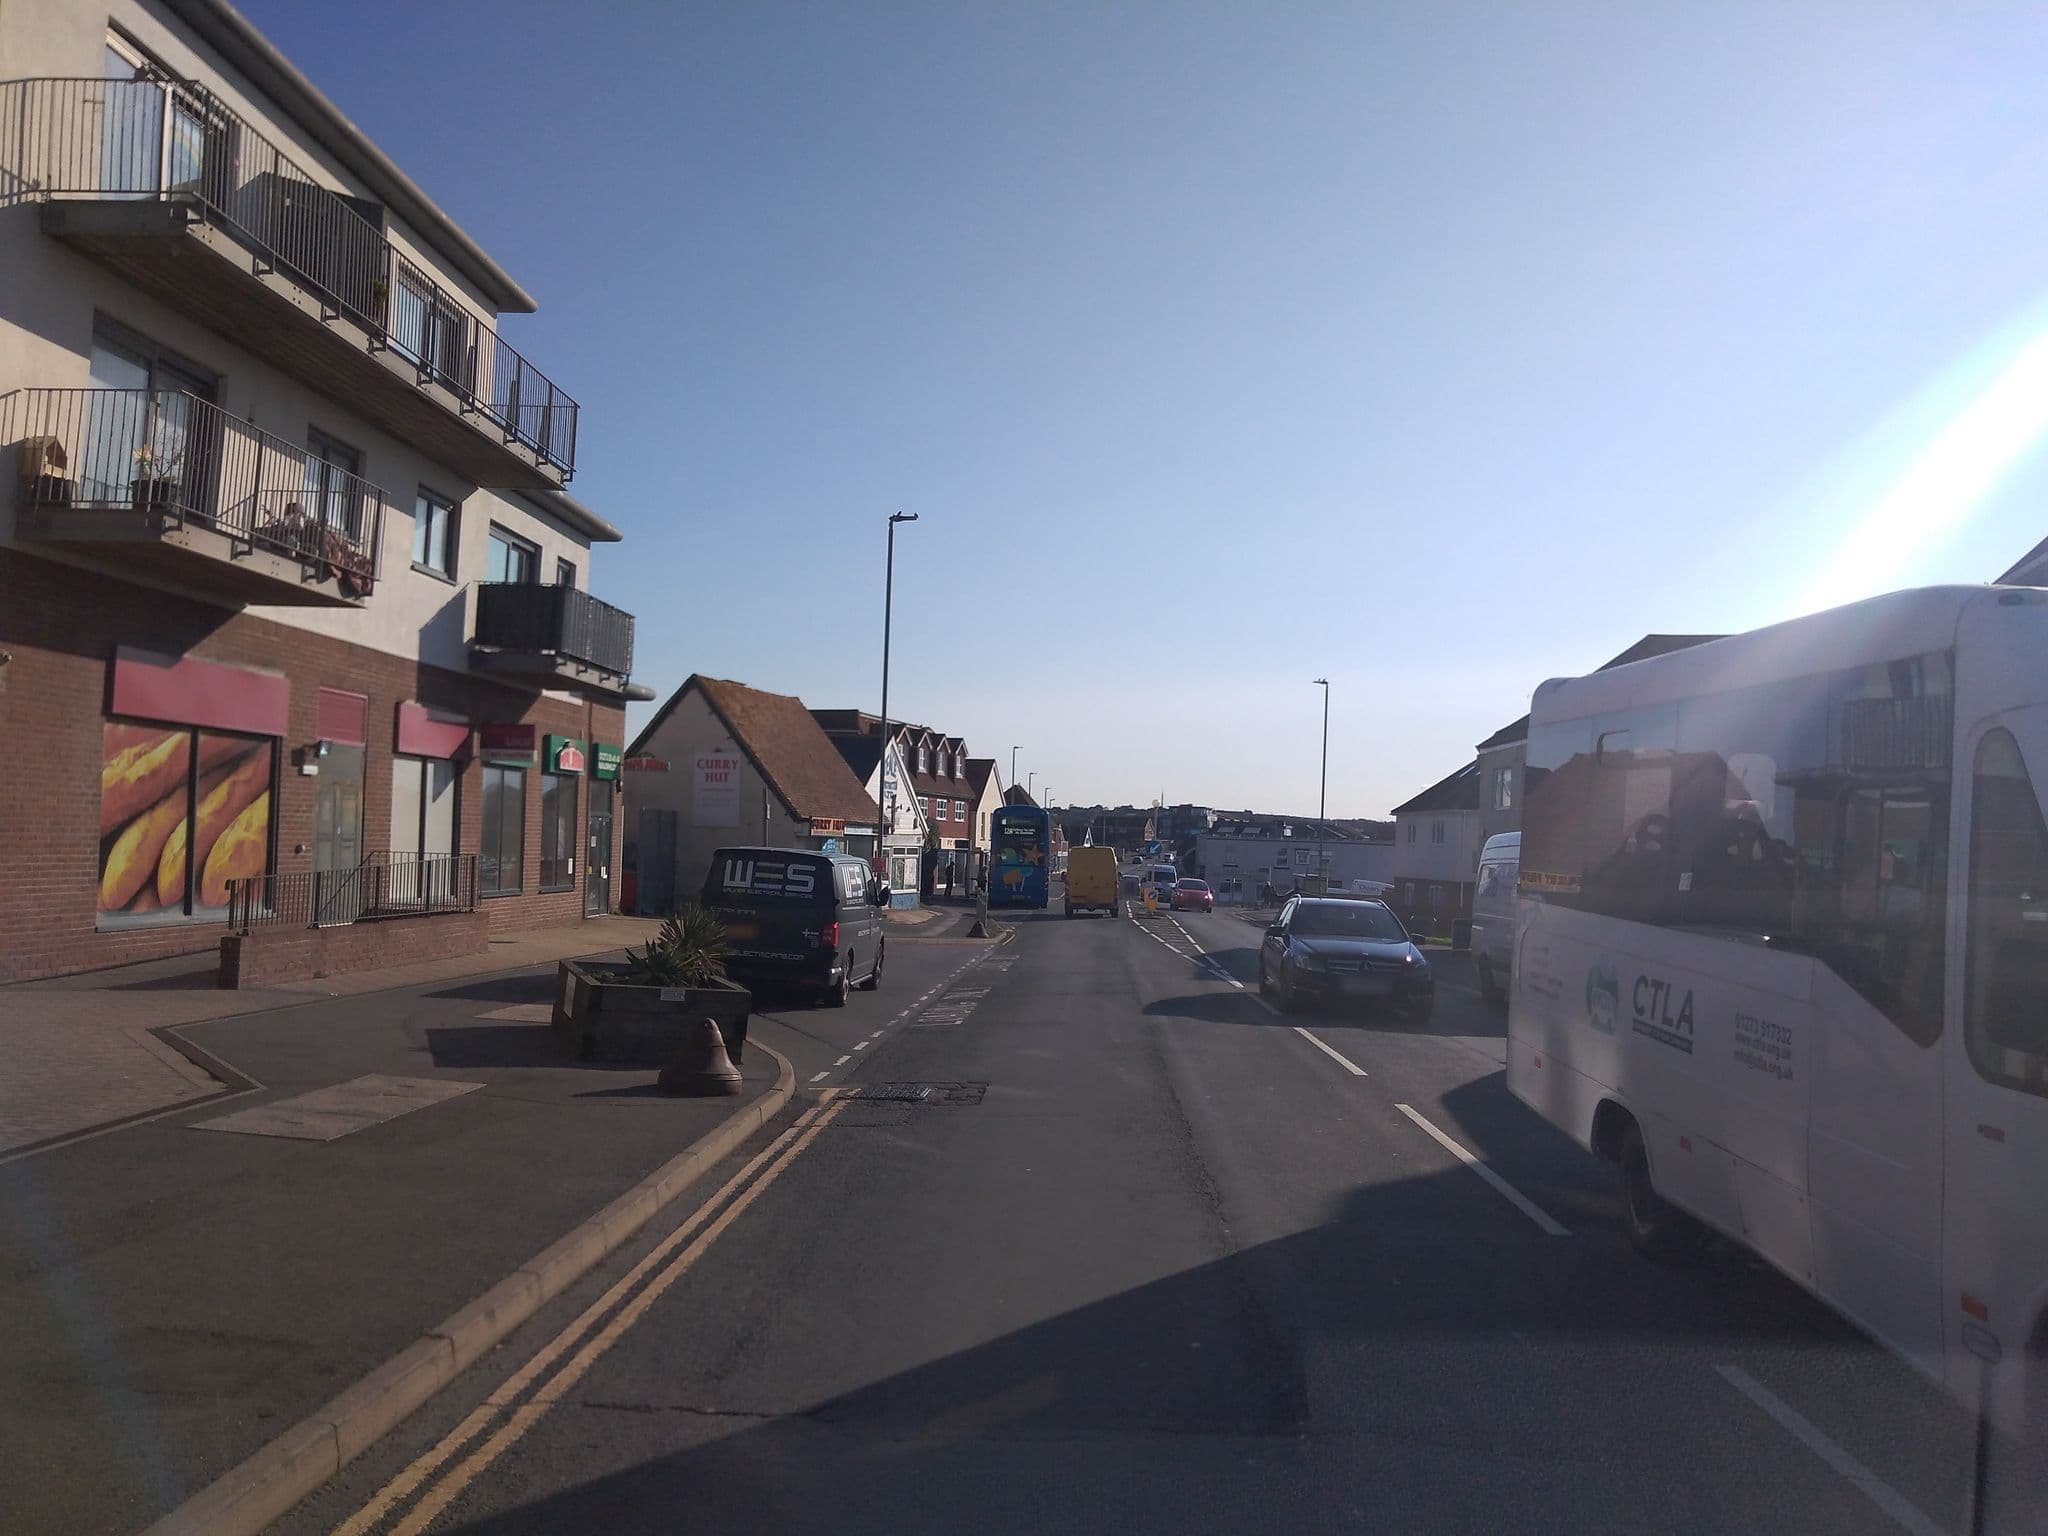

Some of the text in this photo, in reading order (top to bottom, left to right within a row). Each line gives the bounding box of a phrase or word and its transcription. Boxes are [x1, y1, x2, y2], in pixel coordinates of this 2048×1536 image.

[696, 759, 739, 769] CURRY
[705, 772, 730, 783] HUT
[723, 859, 816, 893] WES
[841, 865, 865, 898] WES
[1632, 975, 1694, 1036] CTLA
